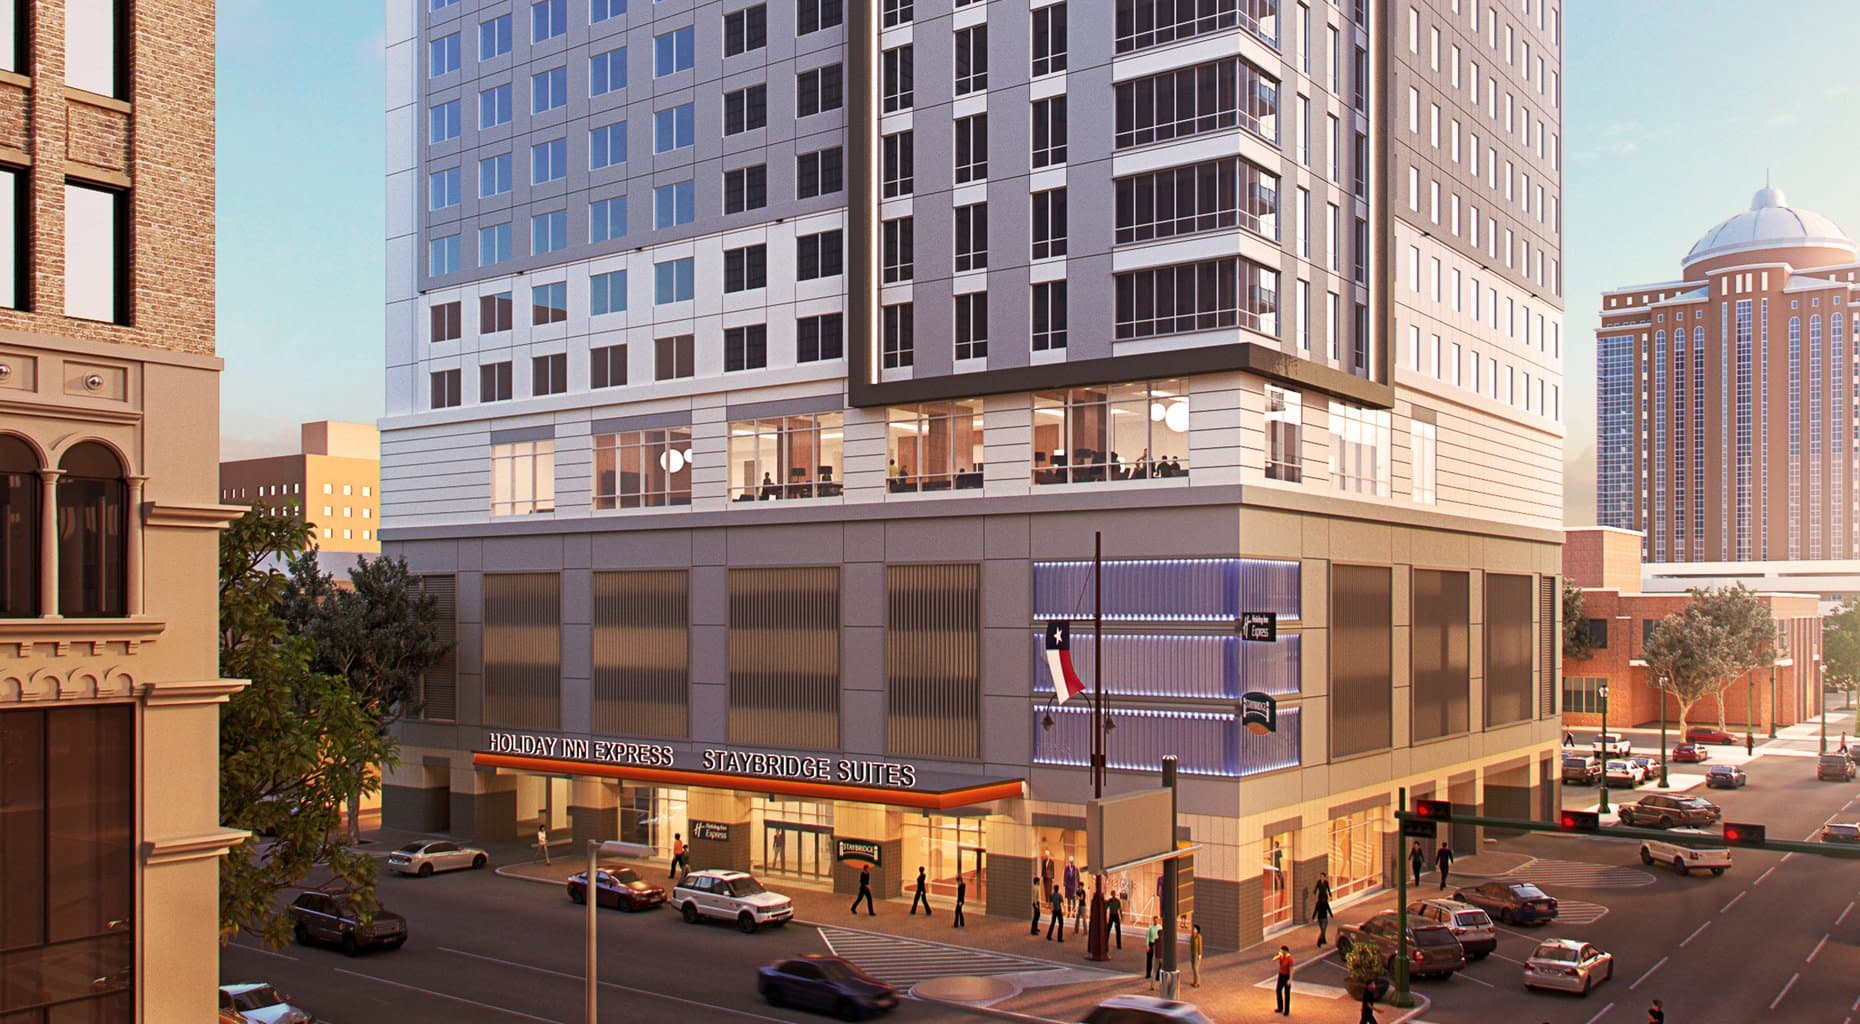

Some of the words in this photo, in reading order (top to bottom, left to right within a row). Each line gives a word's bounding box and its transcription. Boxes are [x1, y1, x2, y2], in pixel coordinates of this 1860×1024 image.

[489, 733, 557, 756] HOLIDAY
[561, 738, 589, 759] INN
[594, 741, 672, 767] EXPRESS
[703, 749, 830, 780] STAYBRIDGE
[837, 759, 916, 787] SUITES
